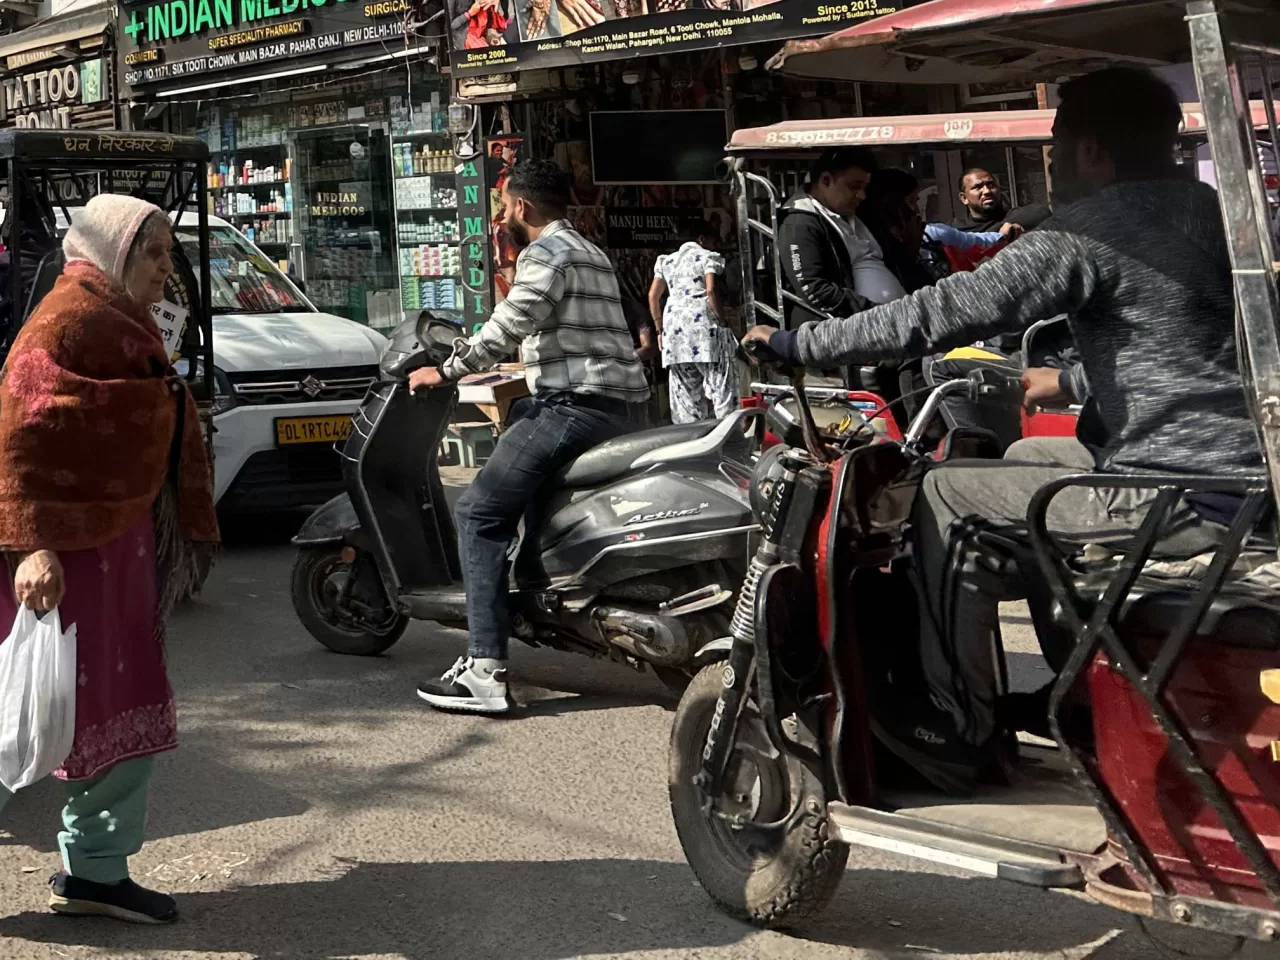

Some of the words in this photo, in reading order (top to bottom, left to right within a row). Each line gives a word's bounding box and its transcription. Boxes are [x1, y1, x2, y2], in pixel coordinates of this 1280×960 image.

[364, 0, 411, 17] SURGICAL
[802, 14, 831, 25] Powered
[846, 9, 875, 20] Sudama
[876, 6, 896, 17] tattoo
[817, 4, 849, 17] Since
[208, 37, 227, 50] SUPER
[228, 28, 264, 47] SPECIALITY
[265, 20, 302, 40] PHARMACY
[537, 41, 562, 52] Address
[612, 32, 627, 42] Main
[628, 29, 648, 40] Bazar
[665, 34, 681, 44] New
[682, 31, 701, 42] Delhi
[706, 26, 733, 38] 110055
[125, 70, 143, 84] SHOP
[172, 62, 184, 77] SIX
[185, 57, 207, 74] TOOTI
[238, 48, 258, 64] MAIN
[289, 37, 317, 55] PAHAR
[344, 27, 362, 43] NEW
[125, 49, 158, 65] COSMETIC
[466, 51, 487, 62] Since
[488, 49, 507, 60] 2000
[3, 63, 79, 111] TATTOO
[946, 119, 970, 132] JBM
[317, 192, 358, 203] INDIAN
[311, 206, 365, 217] MEDICOS
